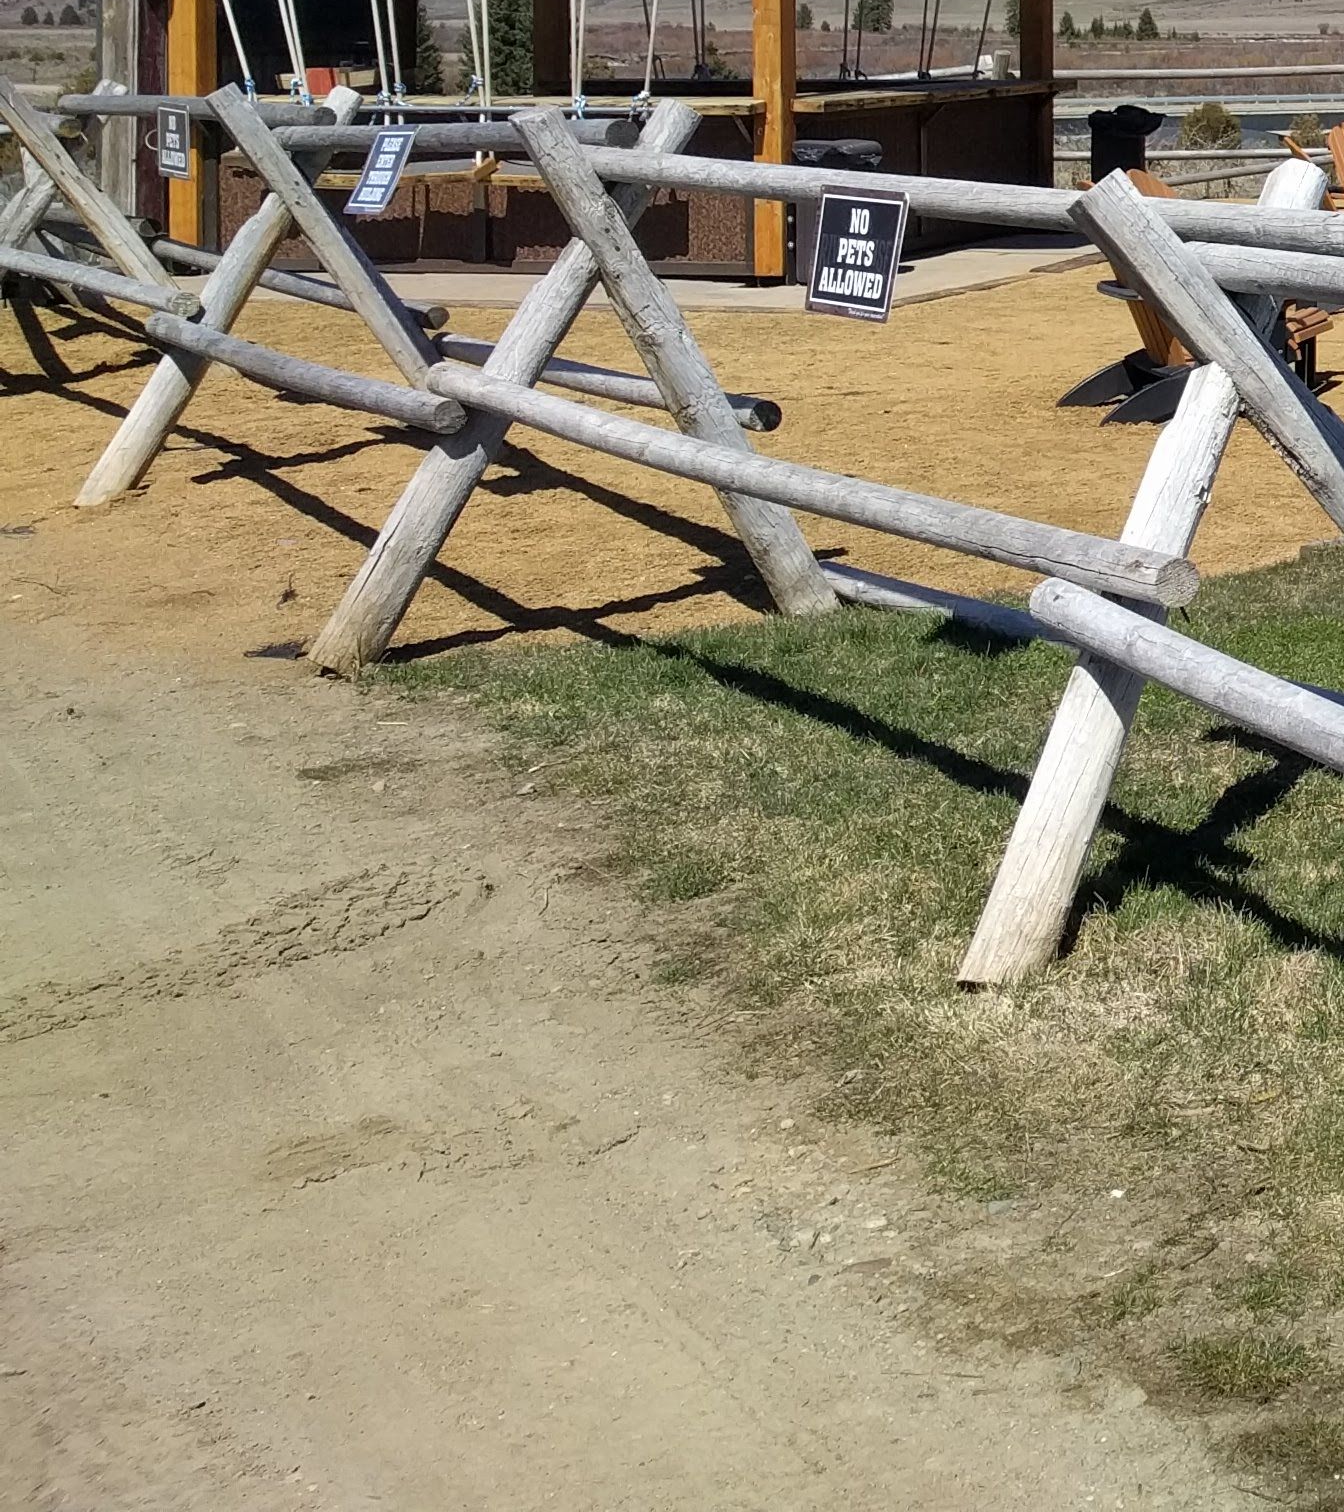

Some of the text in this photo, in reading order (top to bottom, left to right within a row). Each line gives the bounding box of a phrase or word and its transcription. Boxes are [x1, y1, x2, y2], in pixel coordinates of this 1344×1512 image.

[849, 208, 870, 235] NO
[837, 237, 875, 267] PETS
[818, 266, 884, 299] ALLOWED
